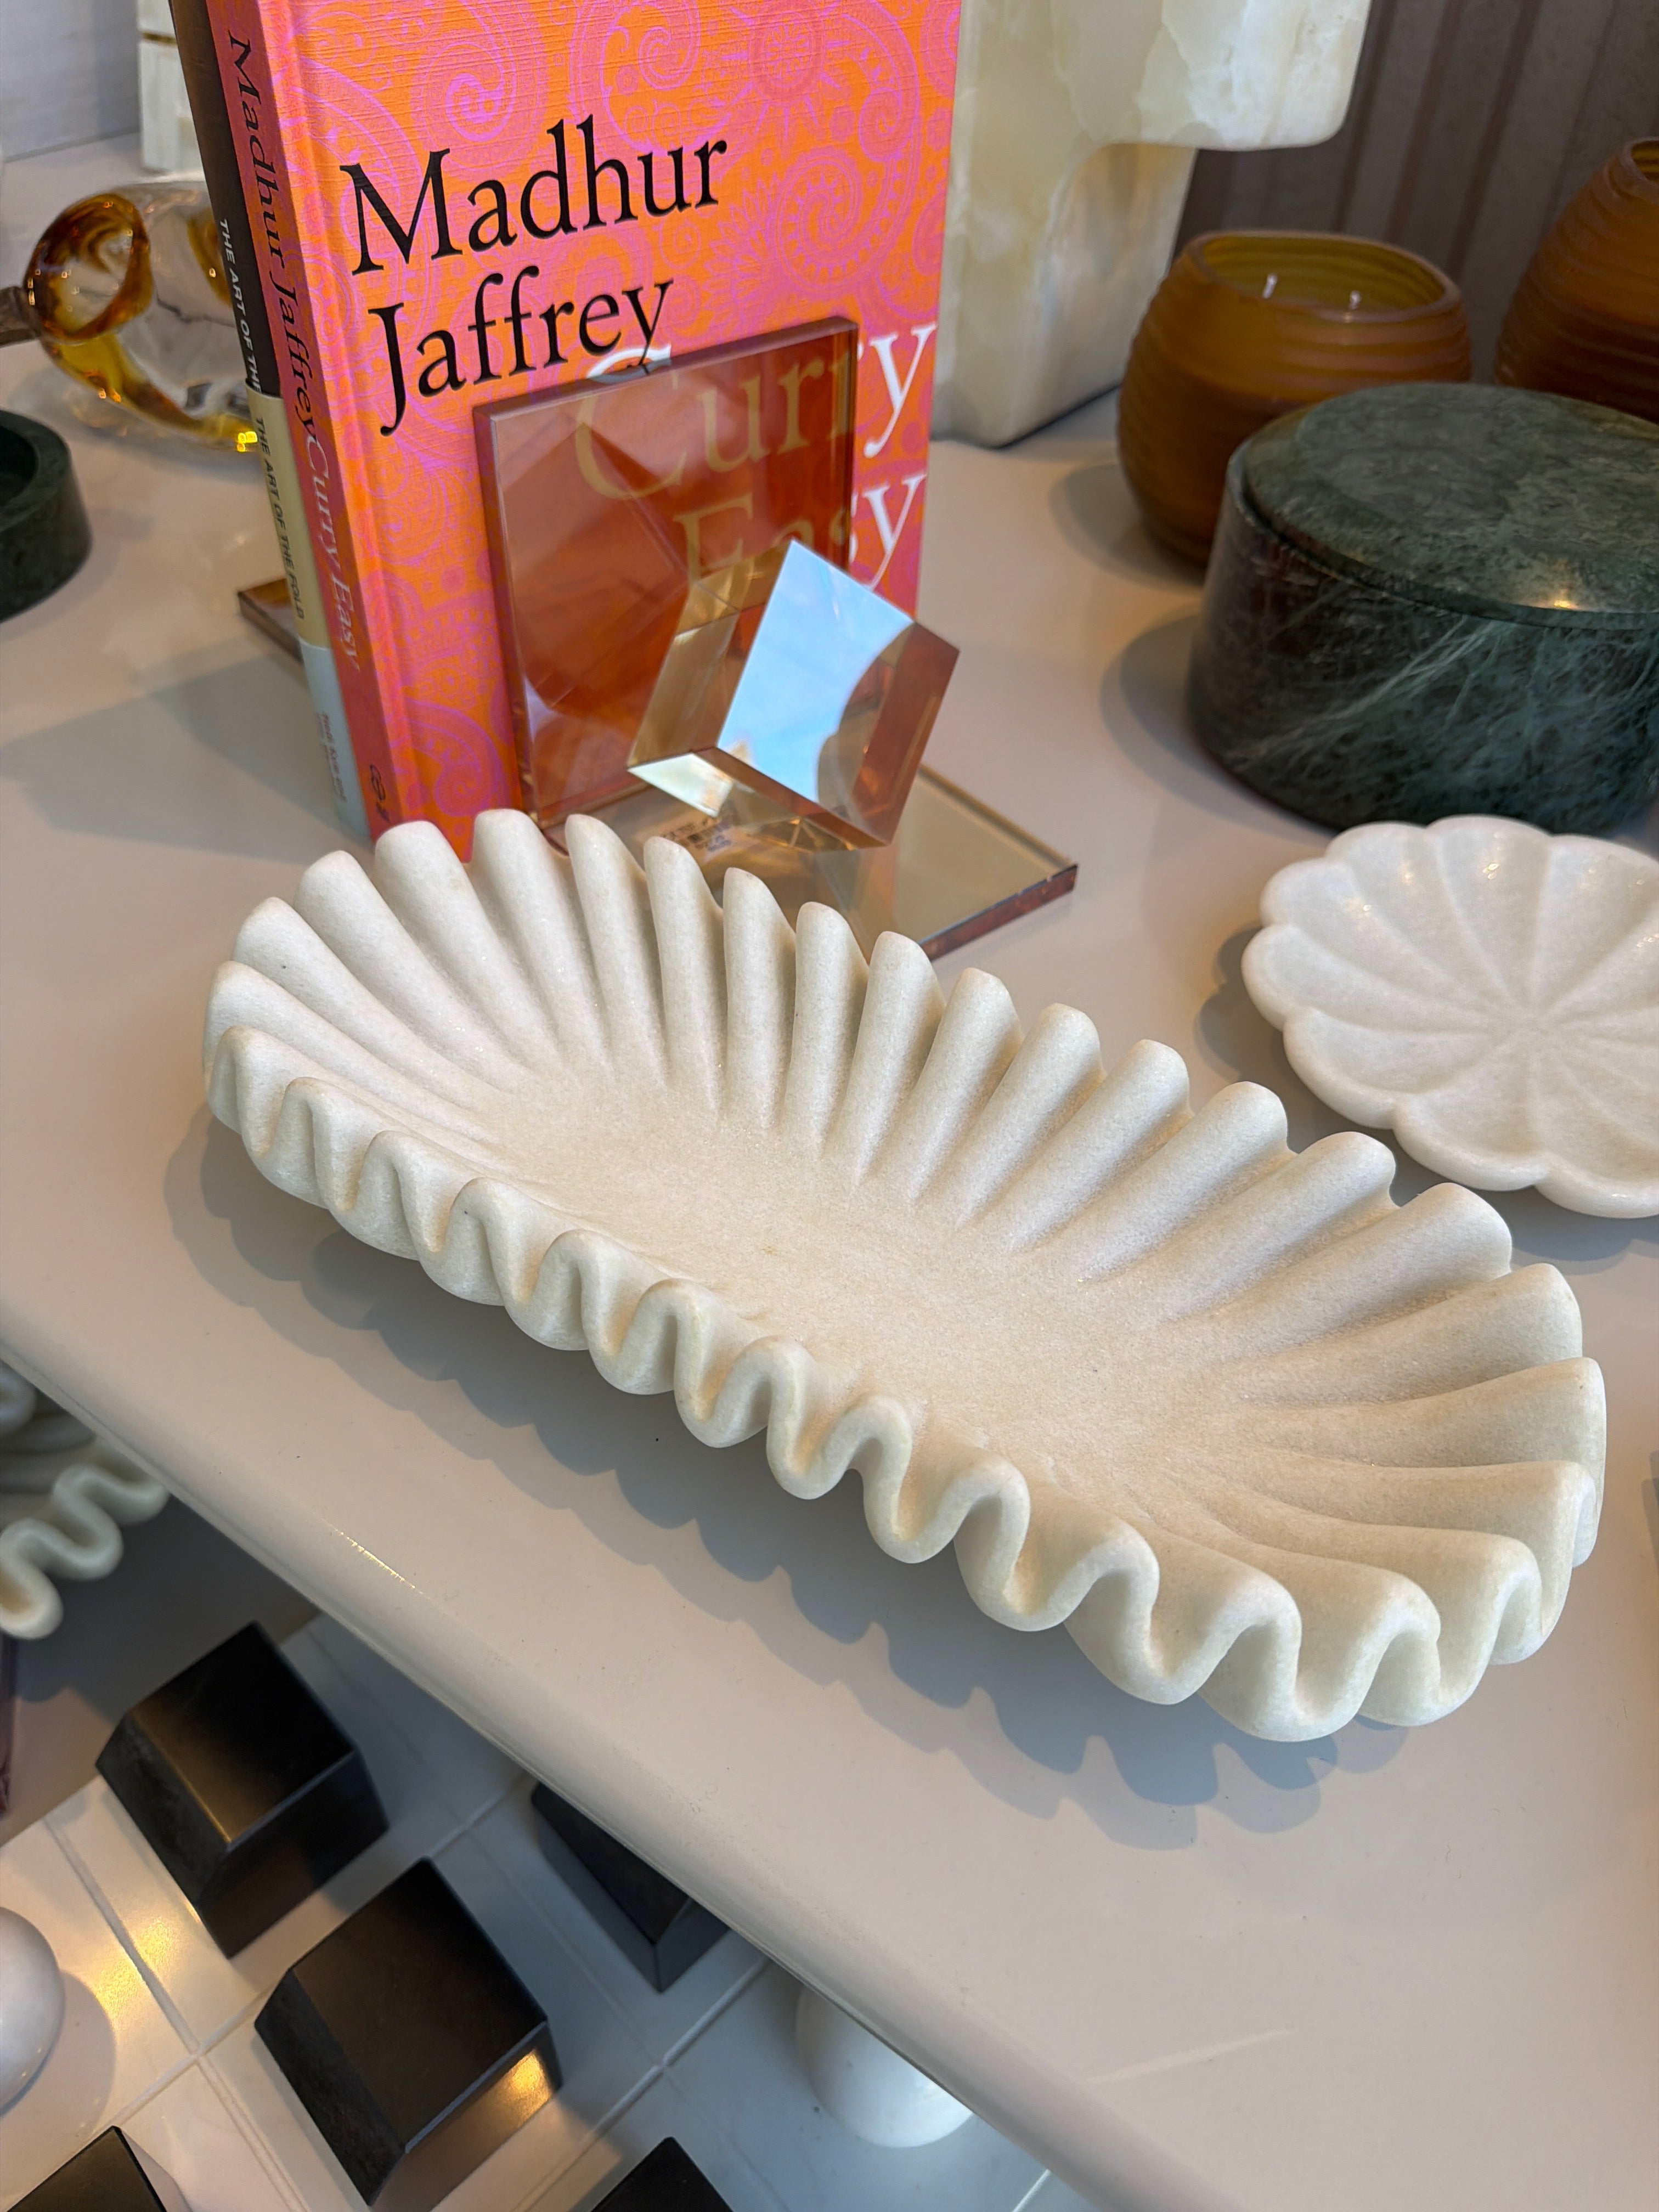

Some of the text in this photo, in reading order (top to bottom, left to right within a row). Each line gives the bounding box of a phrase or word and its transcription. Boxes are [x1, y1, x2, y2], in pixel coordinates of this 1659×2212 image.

[339, 114, 727, 276] Madhur
[219, 218, 235, 264] THE
[229, 267, 246, 317] ART
[240, 319, 254, 352] OF
[228, 30, 285, 269] Madhur
[269, 270, 317, 443] Jaffrey
[306, 435, 341, 571] Curry
[331, 573, 360, 673] Easy
[368, 266, 674, 437] Jaffrey
[256, 416, 305, 620] THE ART OF THE FOLD
